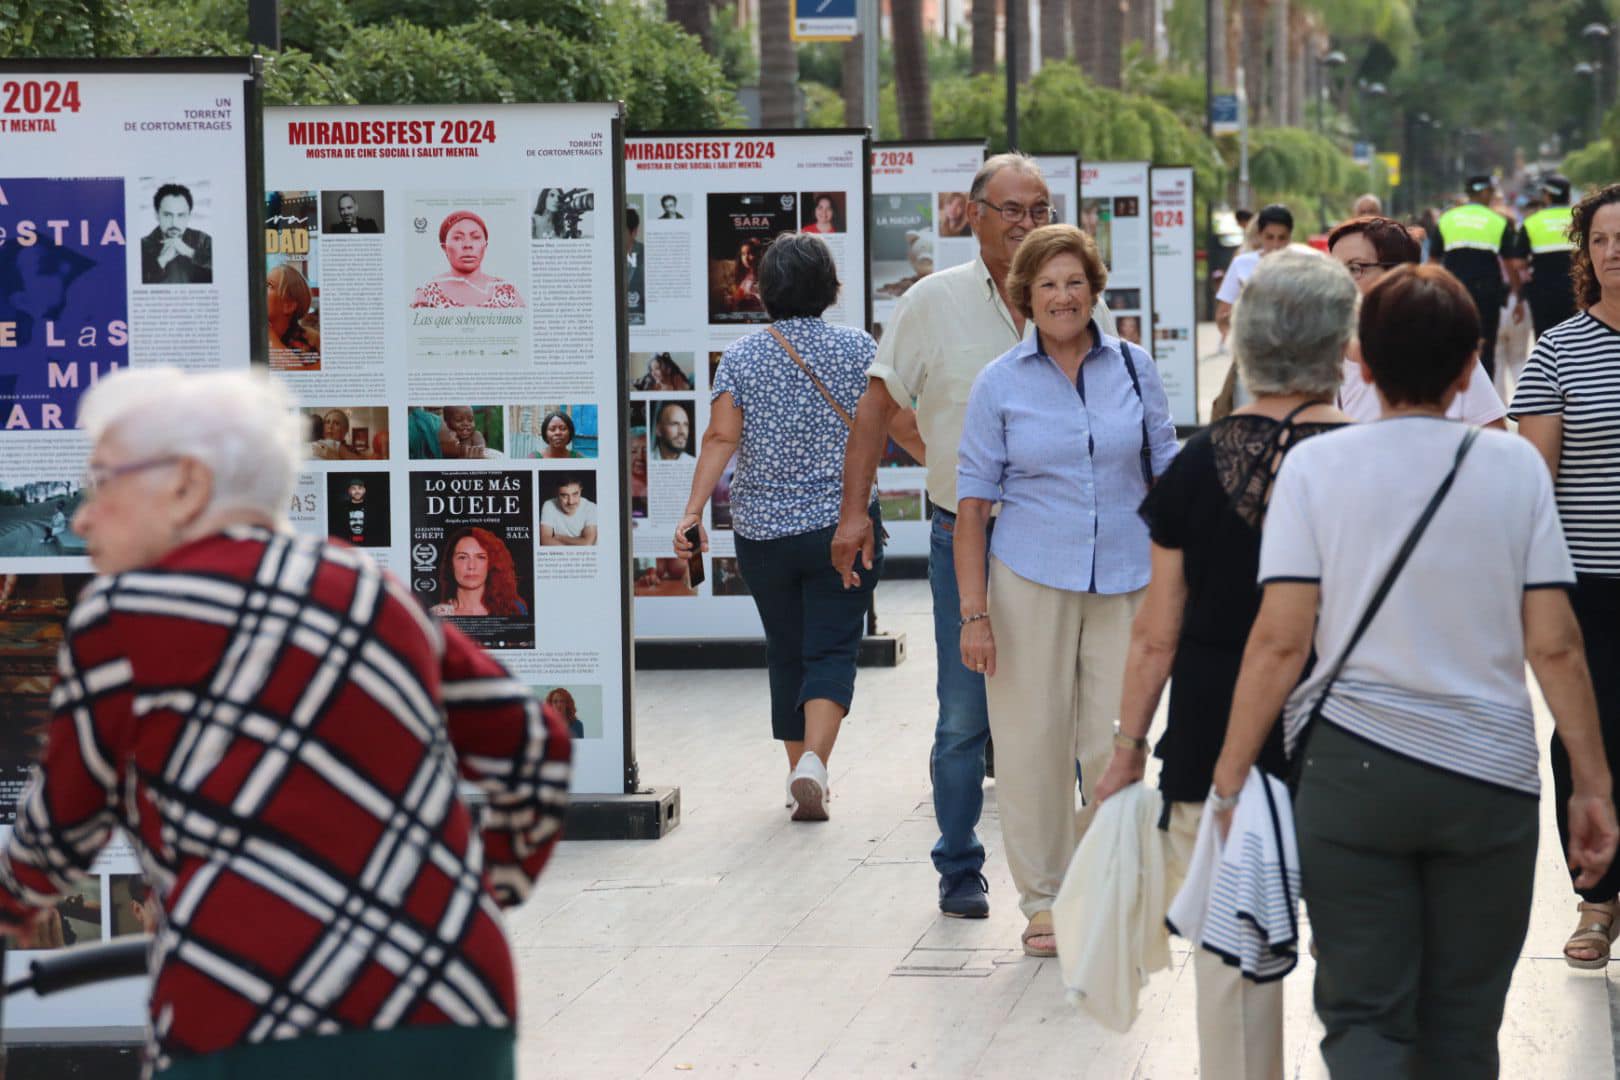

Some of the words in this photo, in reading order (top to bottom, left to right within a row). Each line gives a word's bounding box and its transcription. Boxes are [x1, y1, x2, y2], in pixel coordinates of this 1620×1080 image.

[3, 81, 81, 113] 2024
[215, 98, 232, 107] UN
[184, 109, 232, 119] TORRENT
[10, 119, 57, 132] MENTAL
[124, 121, 137, 131] DE
[140, 121, 232, 131] CORTOMETRAGES
[288, 120, 436, 146] MIRADESFEST
[440, 119, 497, 145] 2024
[569, 140, 603, 148] TORRENT
[624, 142, 731, 161] MIRADESFEST
[734, 141, 776, 160] 2024
[306, 149, 343, 159] MOSTRA
[344, 149, 355, 159] DE
[357, 148, 378, 158] CINE
[379, 148, 410, 158] SOCIAL
[417, 147, 443, 157] SALUT
[446, 146, 479, 158] MENTAL
[881, 151, 914, 167] 2024
[734, 217, 770, 228] SARA
[413, 311, 433, 326] Las
[434, 315, 453, 329] que
[454, 311, 523, 326] sobrevivimos
[425, 479, 446, 491] LO
[450, 478, 484, 494] QUE
[489, 476, 521, 491] MÁS
[426, 495, 521, 515] DUELE
